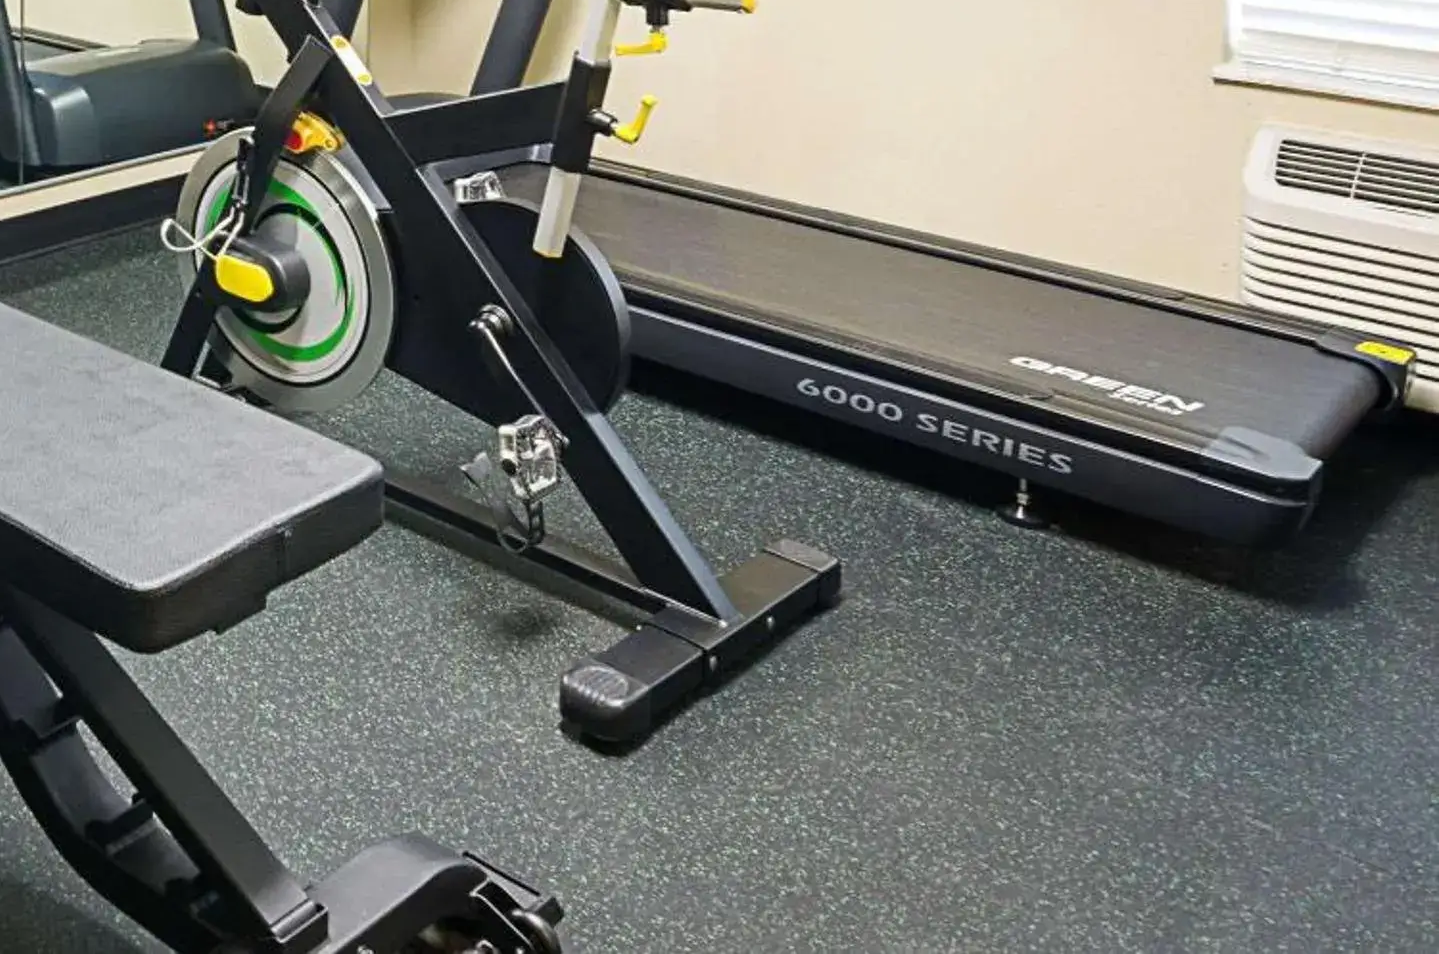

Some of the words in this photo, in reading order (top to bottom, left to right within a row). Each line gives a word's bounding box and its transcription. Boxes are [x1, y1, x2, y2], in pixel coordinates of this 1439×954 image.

[1009, 356, 1205, 412] GREEN
[796, 377, 904, 422] 6000
[915, 412, 1073, 475] SERIES
